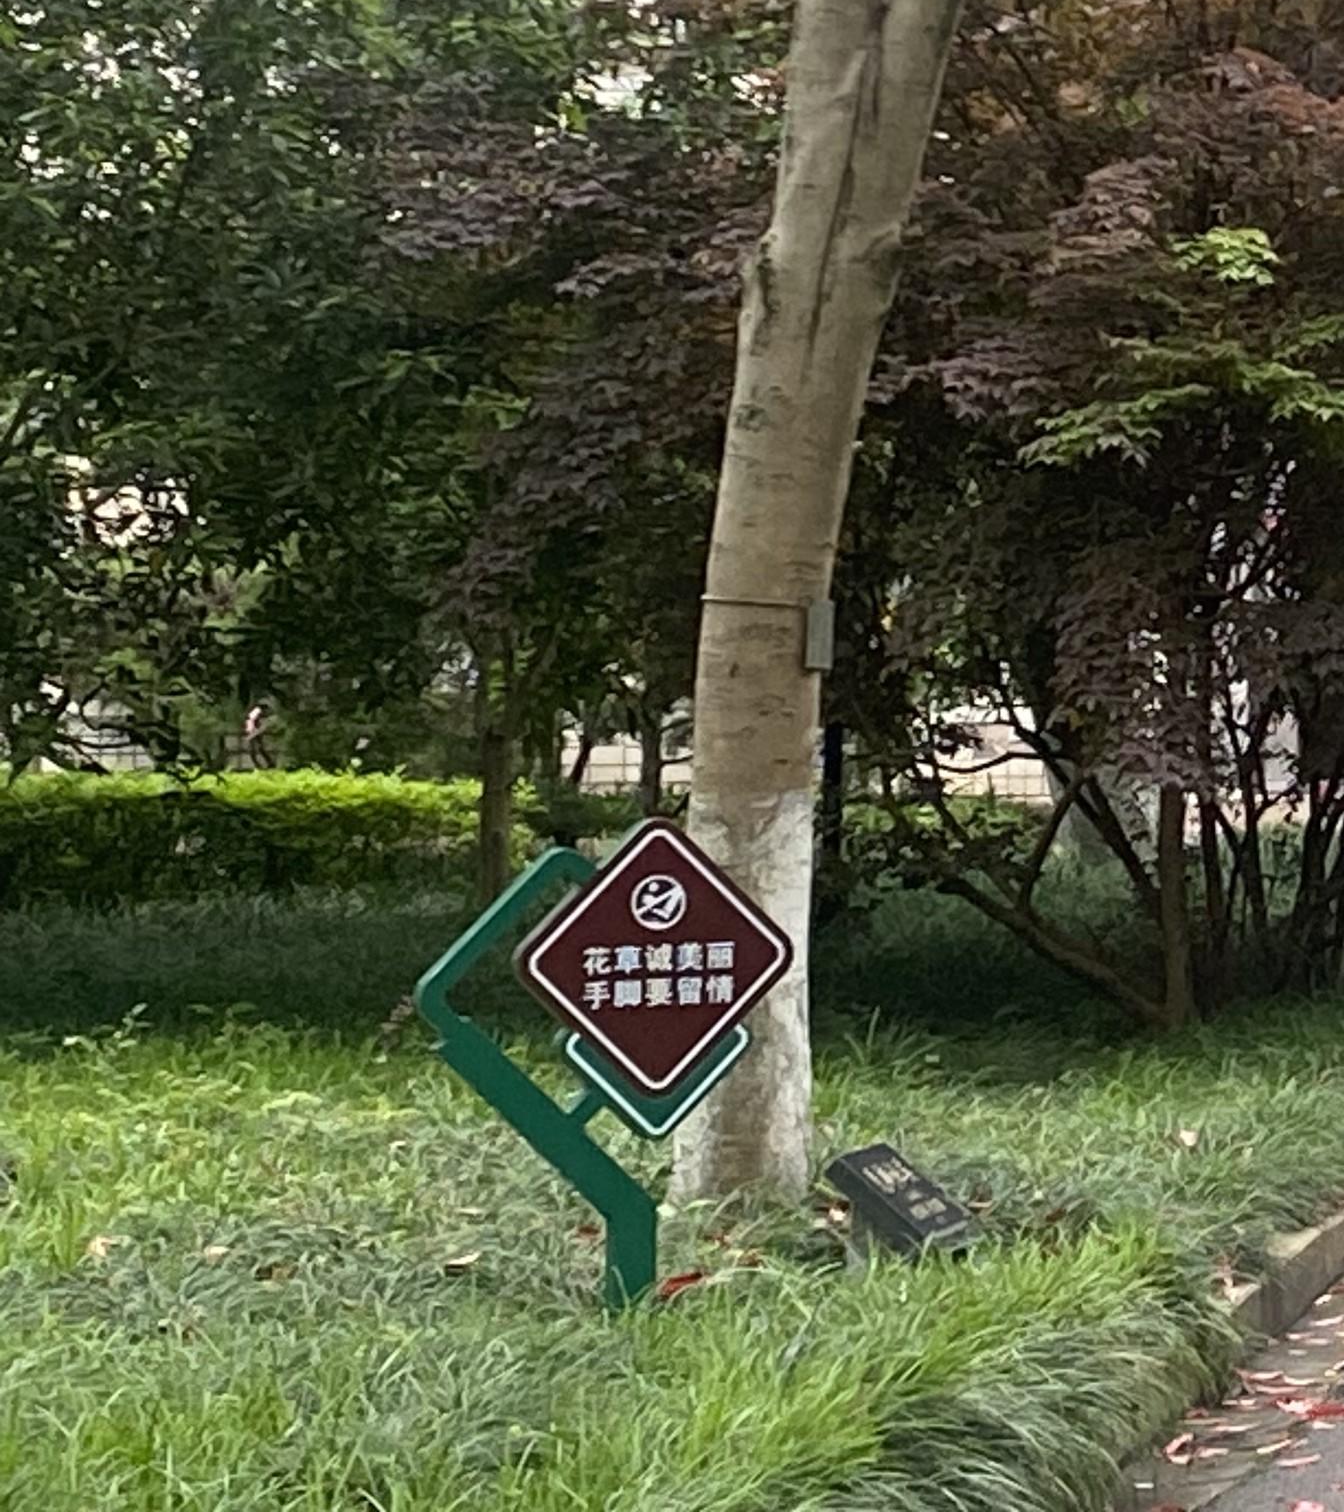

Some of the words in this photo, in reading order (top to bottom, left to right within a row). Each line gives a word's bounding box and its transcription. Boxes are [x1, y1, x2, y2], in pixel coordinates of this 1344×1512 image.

[583, 941, 735, 976] 花草诚美丽
[583, 974, 734, 1010] 手脚要留情
